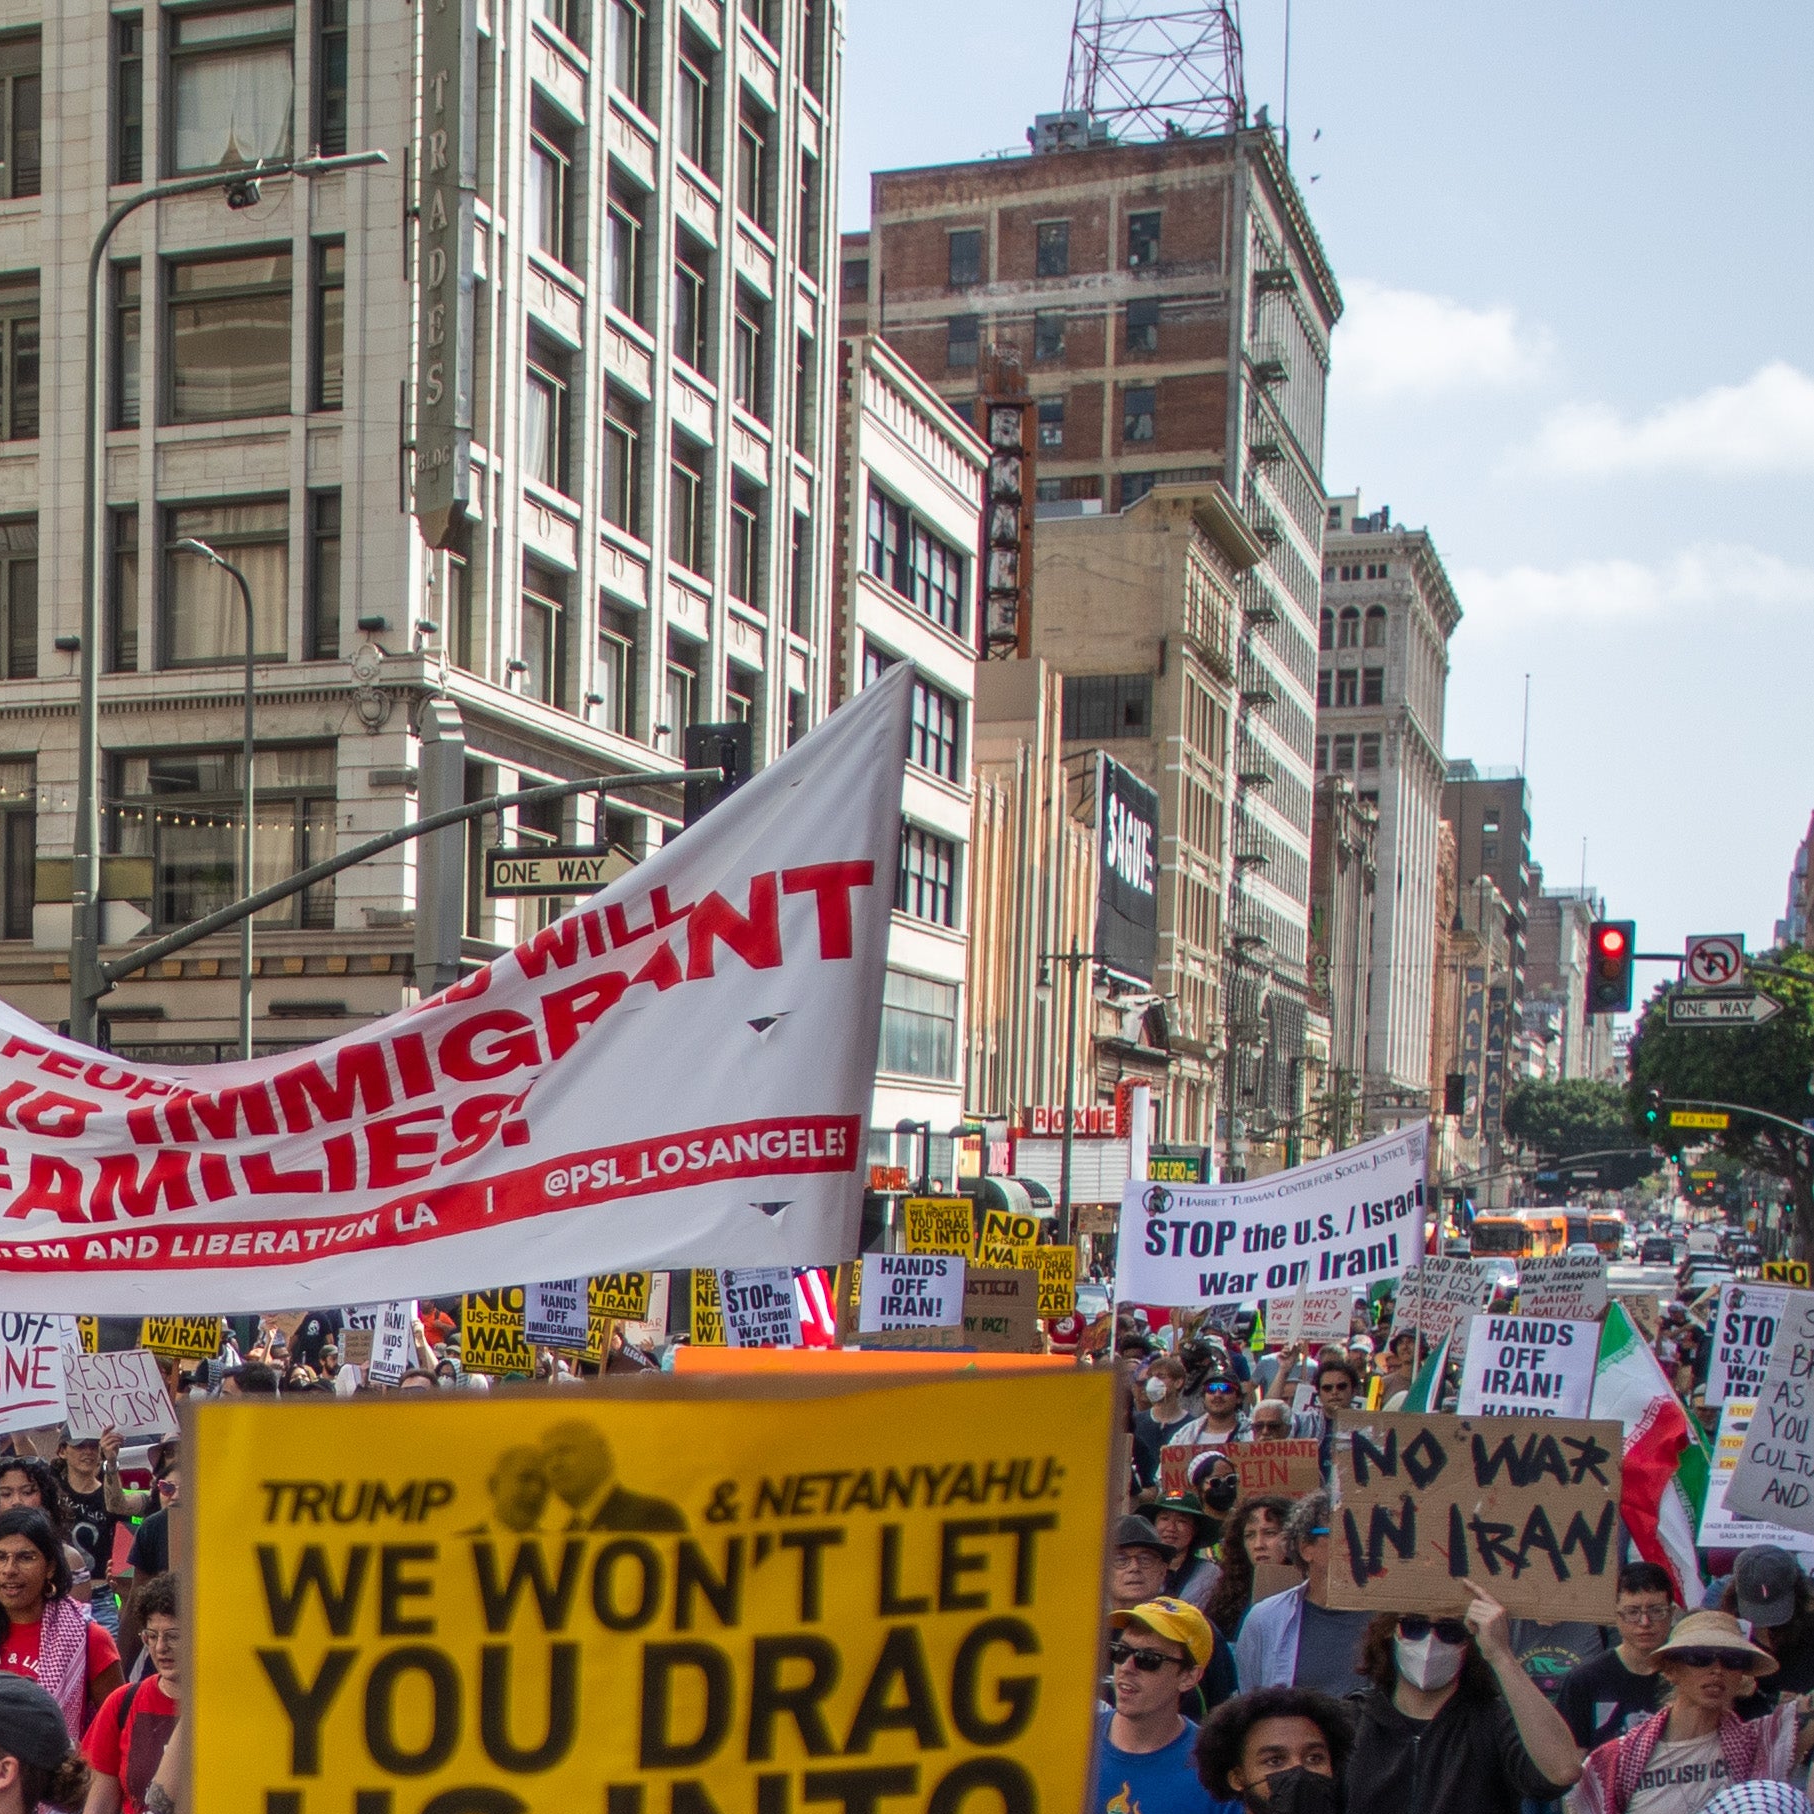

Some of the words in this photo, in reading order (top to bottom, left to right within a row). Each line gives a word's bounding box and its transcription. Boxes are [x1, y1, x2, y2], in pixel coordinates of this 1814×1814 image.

[425, 70, 449, 406] TRADES
[496, 860, 541, 884] ONE
[557, 859, 606, 883] WAY
[514, 888, 697, 982] WILL
[1675, 1002, 1708, 1016] ONE
[1719, 1002, 1752, 1015] WAY
[1034, 1106, 1116, 1132] ROXIE
[1674, 1116, 1695, 1124] PED
[1700, 1117, 1724, 1125] XING
[543, 1125, 847, 1198] @PSL_LOSANGELES
[1277, 1180, 1314, 1198] CENTER
[1335, 1160, 1370, 1180] SOCIAL
[1372, 1145, 1405, 1170] JUSTICE
[84, 1235, 160, 1261] AND
[170, 1211, 377, 1259] LIBERATION
[393, 1201, 438, 1232] LA
[911, 1231, 932, 1243] US
[934, 1230, 970, 1245] INTO
[935, 1218, 969, 1231] DRAG
[987, 1215, 1036, 1239] NO
[1144, 1218, 1237, 1257] STOP
[1242, 1223, 1287, 1254] the
[1293, 1212, 1340, 1246] U.S.
[880, 1257, 948, 1277] HANDS
[1198, 1270, 1258, 1297] War
[1266, 1260, 1309, 1289] on
[1319, 1233, 1400, 1282] Iran!
[1766, 1264, 1809, 1286] NO
[588, 1272, 644, 1297] WAR
[892, 1278, 927, 1295] OFF
[541, 1294, 577, 1310] HANDS
[726, 1284, 774, 1313] STOP
[880, 1296, 943, 1317] IRAN!
[1, 1312, 54, 1345] OFF
[528, 1322, 586, 1337] IMMIGRANTS!
[546, 1309, 568, 1324] OFF
[147, 1325, 170, 1345] W/
[173, 1327, 217, 1349] IRAN
[467, 1326, 529, 1354] WAR
[737, 1325, 768, 1338] War
[1488, 1319, 1575, 1346] HANDS
[465, 1351, 487, 1364] ON
[1498, 1347, 1545, 1370] OFF
[63, 1351, 153, 1392] RESIST
[1481, 1369, 1564, 1399] IRAN!
[1775, 1382, 1805, 1409] AS
[66, 1390, 179, 1429] FASCISM
[1769, 1406, 1809, 1444] YOU
[1162, 1446, 1183, 1462] NO
[1274, 1441, 1318, 1458] HATE
[1349, 1427, 1448, 1491] NO
[1473, 1430, 1612, 1488] WAR
[259, 1477, 455, 1526] TRUMP
[701, 1479, 739, 1526] &
[751, 1455, 1066, 1521] NETANYAHU:
[1761, 1480, 1809, 1509] AND
[1342, 1493, 1416, 1589] IN
[1448, 1498, 1615, 1583] IRAN
[254, 1542, 437, 1639] WE
[469, 1526, 845, 1633] WON'T
[875, 1512, 1062, 1620] LET
[254, 1639, 581, 1778] YOU
[636, 1613, 1040, 1772] DRAG
[1637, 1763, 1707, 1791] ABOLISH
